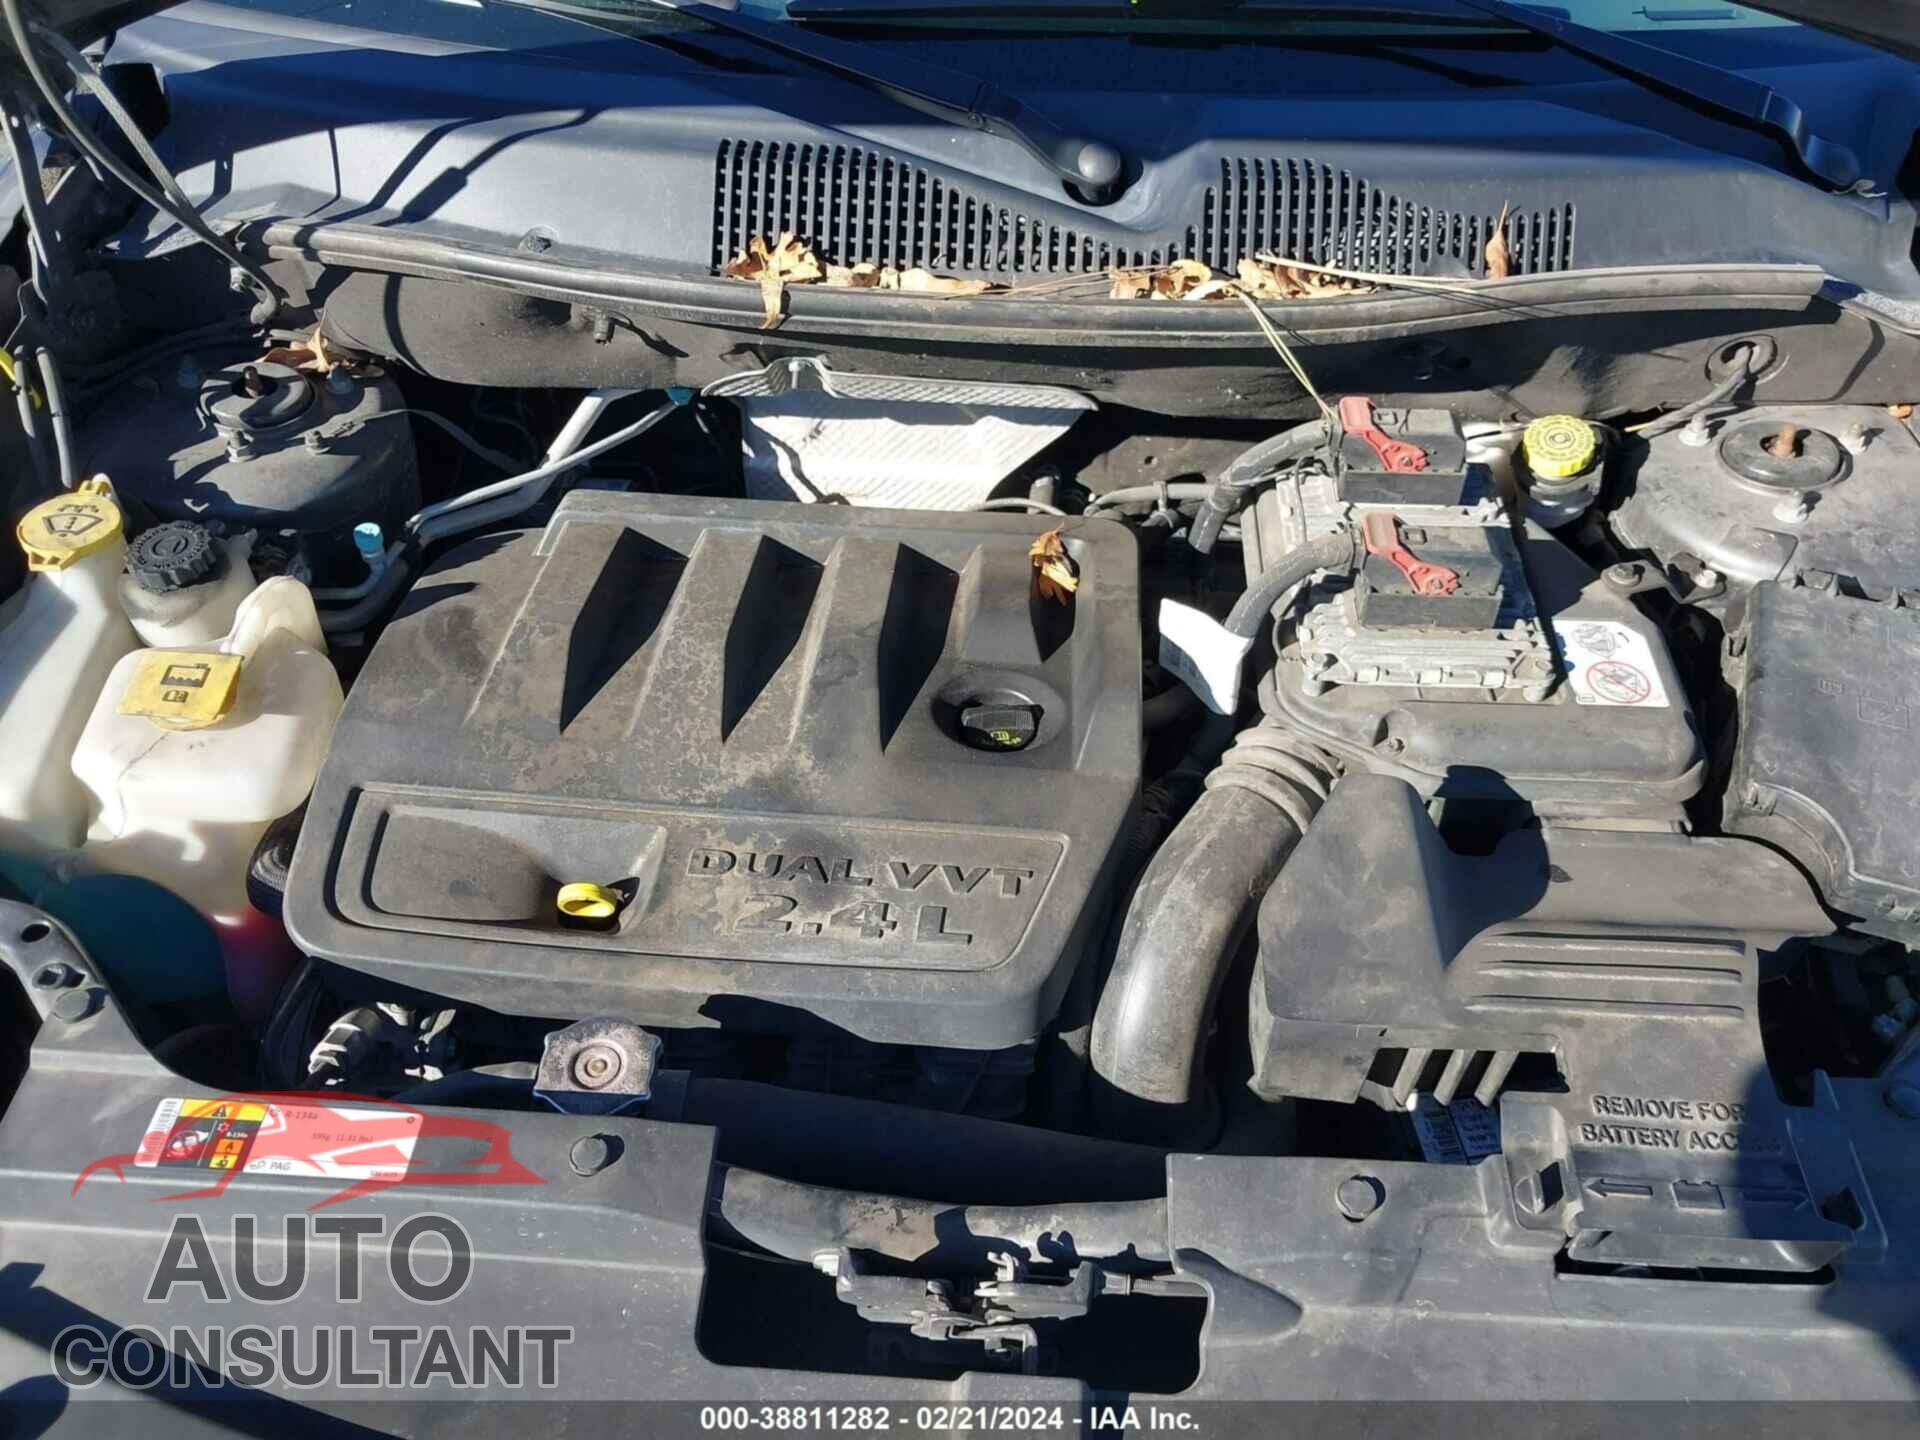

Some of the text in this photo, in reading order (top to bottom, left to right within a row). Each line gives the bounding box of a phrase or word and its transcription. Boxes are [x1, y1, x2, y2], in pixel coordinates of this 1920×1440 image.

[687, 848, 1035, 897] DUAL VVT
[732, 893, 973, 946] 2.4L
[1592, 1094, 1748, 1122] REMOVE FOR
[1581, 1122, 1782, 1153] BATTERY ACC
[269, 1161, 292, 1172] PAG
